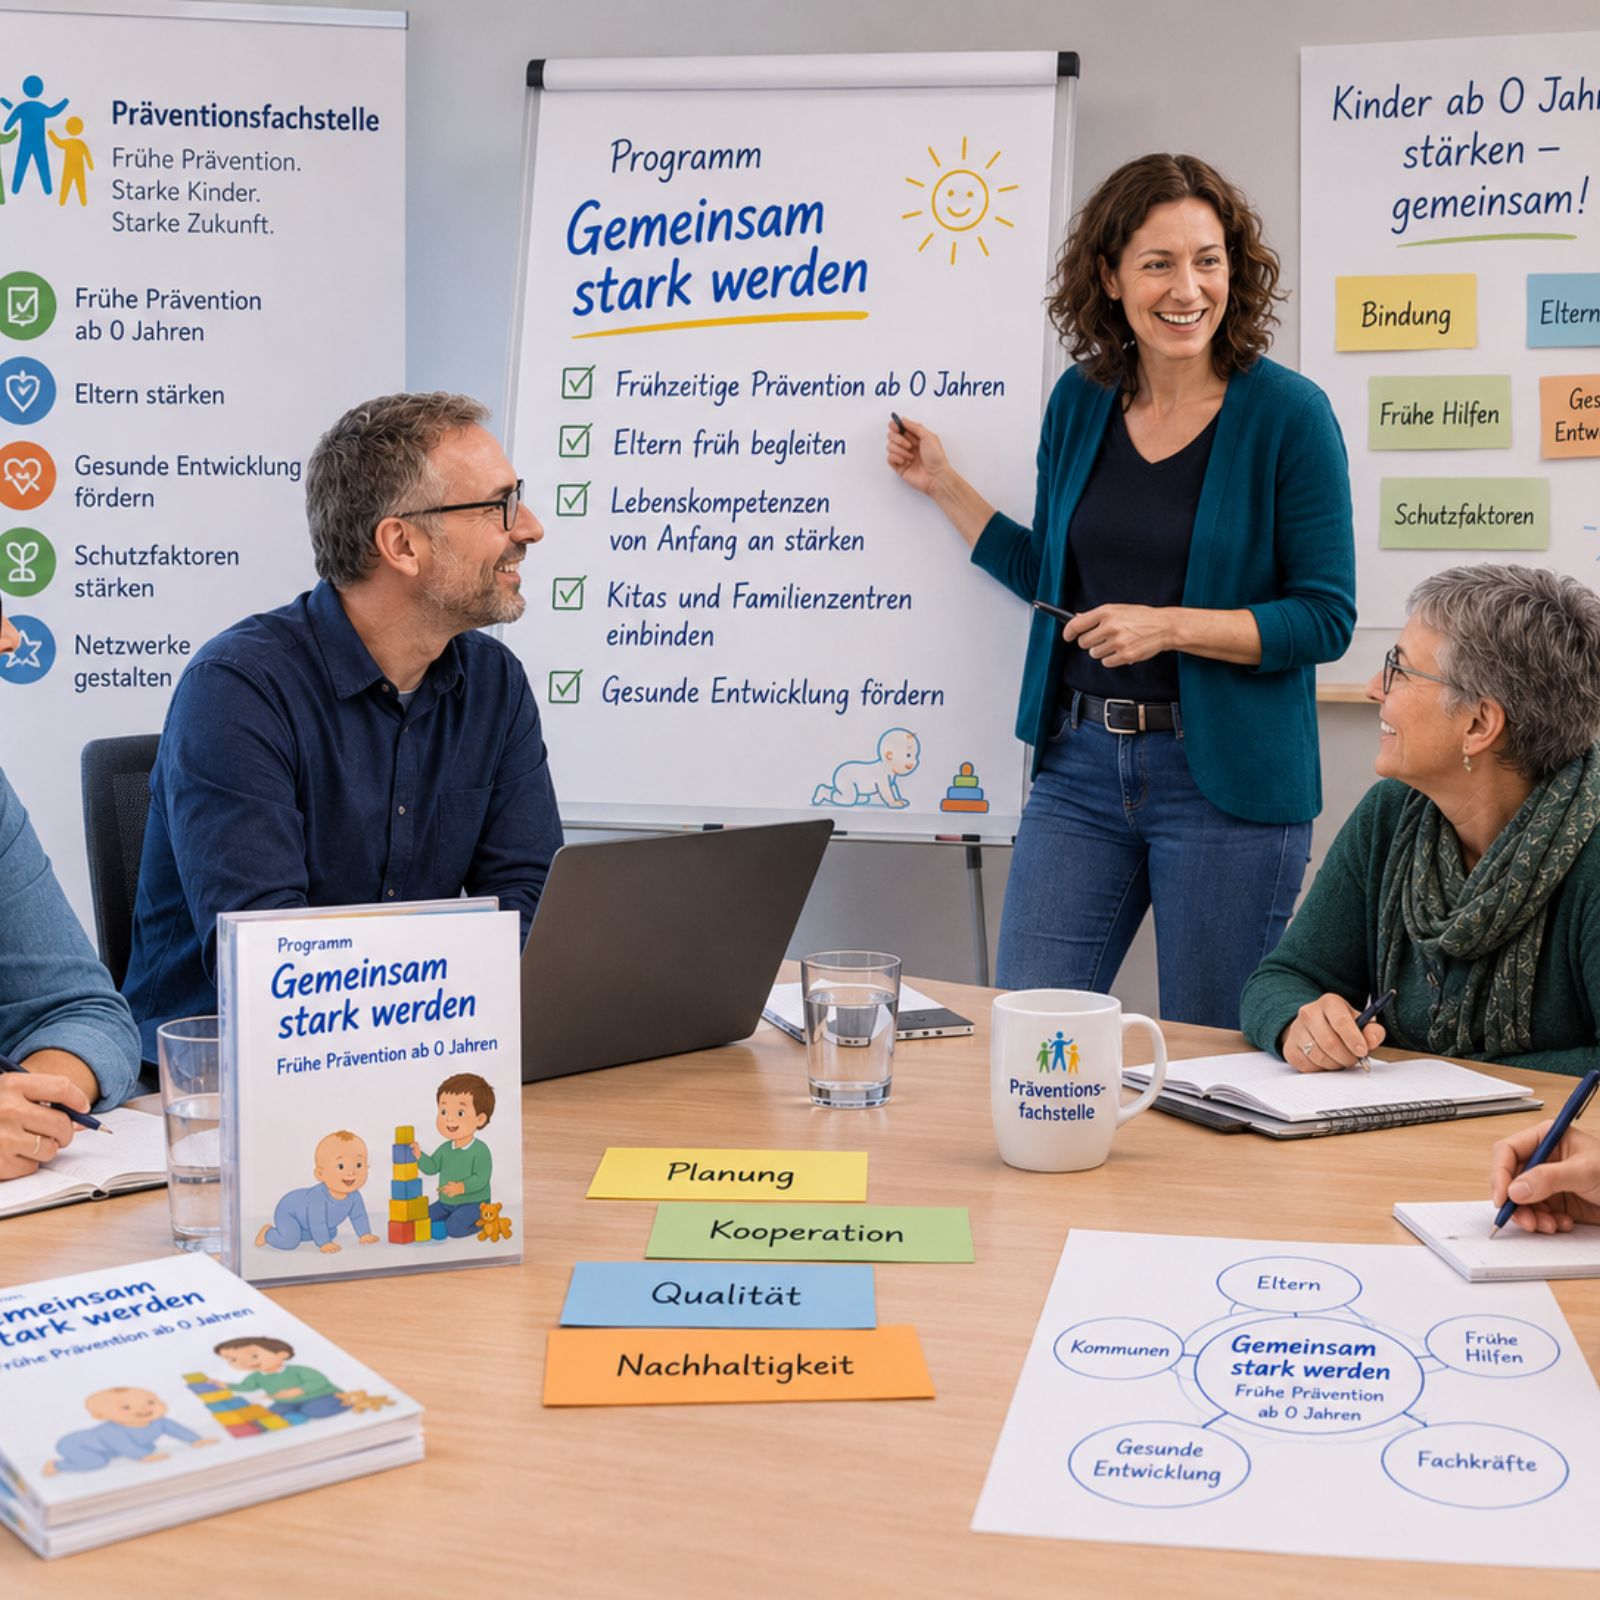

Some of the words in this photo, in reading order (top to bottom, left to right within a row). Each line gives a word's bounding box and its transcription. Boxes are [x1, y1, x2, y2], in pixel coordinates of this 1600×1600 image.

[1333, 84, 1432, 121] Kinder
[1447, 80, 1483, 115] ab
[113, 101, 379, 131] Präventionsfachstelle
[113, 147, 173, 169] Frühe
[183, 149, 301, 171] Prävention.
[612, 139, 761, 183] Programm
[1404, 131, 1523, 168] stärken
[113, 179, 179, 201] Starke
[189, 181, 260, 202] Kinder.
[1391, 176, 1589, 234] gemeinsam!
[113, 212, 180, 232] Starke
[188, 213, 273, 234] Zukunft.
[567, 198, 823, 256] Gemeinsam
[572, 258, 692, 316] stark
[712, 246, 867, 303] werden
[76, 288, 138, 309] Frühe
[147, 289, 261, 310] Prävention
[76, 320, 102, 340] ab
[110, 320, 124, 340] 0
[132, 320, 203, 341] Jahren
[1362, 301, 1450, 334] Bindung
[76, 383, 138, 404] Eltern
[147, 384, 224, 404] stärken
[617, 370, 739, 406] Frühzeitige
[752, 370, 864, 396] Prävention
[875, 372, 900, 396] ab
[934, 371, 1004, 397] Jahren
[1381, 402, 1434, 425] Frühe
[1443, 400, 1499, 427] Hilfen
[615, 428, 681, 455] Eltern
[694, 429, 739, 458] früh
[751, 429, 845, 464] begleiten
[75, 455, 168, 476] Gesunde
[178, 455, 301, 482] Entwicklung
[75, 486, 154, 507] fördern
[612, 487, 829, 522] Lebenskompetenzen
[1395, 503, 1533, 528] Schutzfaktoren
[75, 544, 239, 565] Schutzfaktoren
[610, 535, 646, 550] von
[657, 525, 737, 560] Anfang
[748, 536, 773, 550] an
[785, 526, 864, 551] stärken
[75, 577, 153, 597] stärken
[608, 581, 666, 608] Kitas
[679, 583, 720, 608] und
[734, 582, 911, 609] Familienzentren
[76, 634, 190, 655] Netzwerke
[607, 620, 713, 646] einbinden
[75, 666, 172, 692] gestalten
[603, 675, 699, 705] Gesunde
[712, 677, 849, 715] Entwicklung
[861, 678, 943, 705] fördern
[278, 937, 352, 956] Programm
[271, 957, 447, 999] Gemeinsam
[278, 999, 359, 1039] stark
[371, 988, 475, 1027] werden
[278, 1056, 321, 1075] Frühe
[327, 1047, 406, 1068] Prävention
[411, 1043, 429, 1058] ab
[434, 1041, 444, 1056] 0
[449, 1038, 497, 1055] Jahren
[1011, 1079, 1106, 1098] Präventions-
[1019, 1102, 1094, 1121] fachstelle
[668, 1162, 793, 1189] Planung
[710, 1220, 903, 1247] Kooperation
[652, 1282, 800, 1305] Qualität
[1258, 1276, 1320, 1290] Eltern
[82, 1291, 205, 1325] werden
[50, 1330, 149, 1358] Prävention
[152, 1324, 175, 1336] ab
[177, 1319, 192, 1330] 0
[196, 1307, 254, 1327] Jahren
[1231, 1334, 1376, 1356] Gemeinsam
[1466, 1331, 1517, 1345] Frühe
[1071, 1340, 1169, 1357] Kommunen
[1466, 1349, 1523, 1364] Hilfen
[617, 1353, 853, 1384] Nachhaltigkeit
[1231, 1360, 1295, 1377] stark
[1304, 1362, 1390, 1380] werden
[1235, 1384, 1284, 1398] Frühe
[1292, 1386, 1384, 1401] Prävention
[1258, 1405, 1278, 1418] ab
[1304, 1407, 1361, 1420] Jahren
[1116, 1439, 1203, 1457] Gesunde
[1094, 1461, 1221, 1487] Entwicklung
[1419, 1451, 1536, 1472] Fachkräfte
